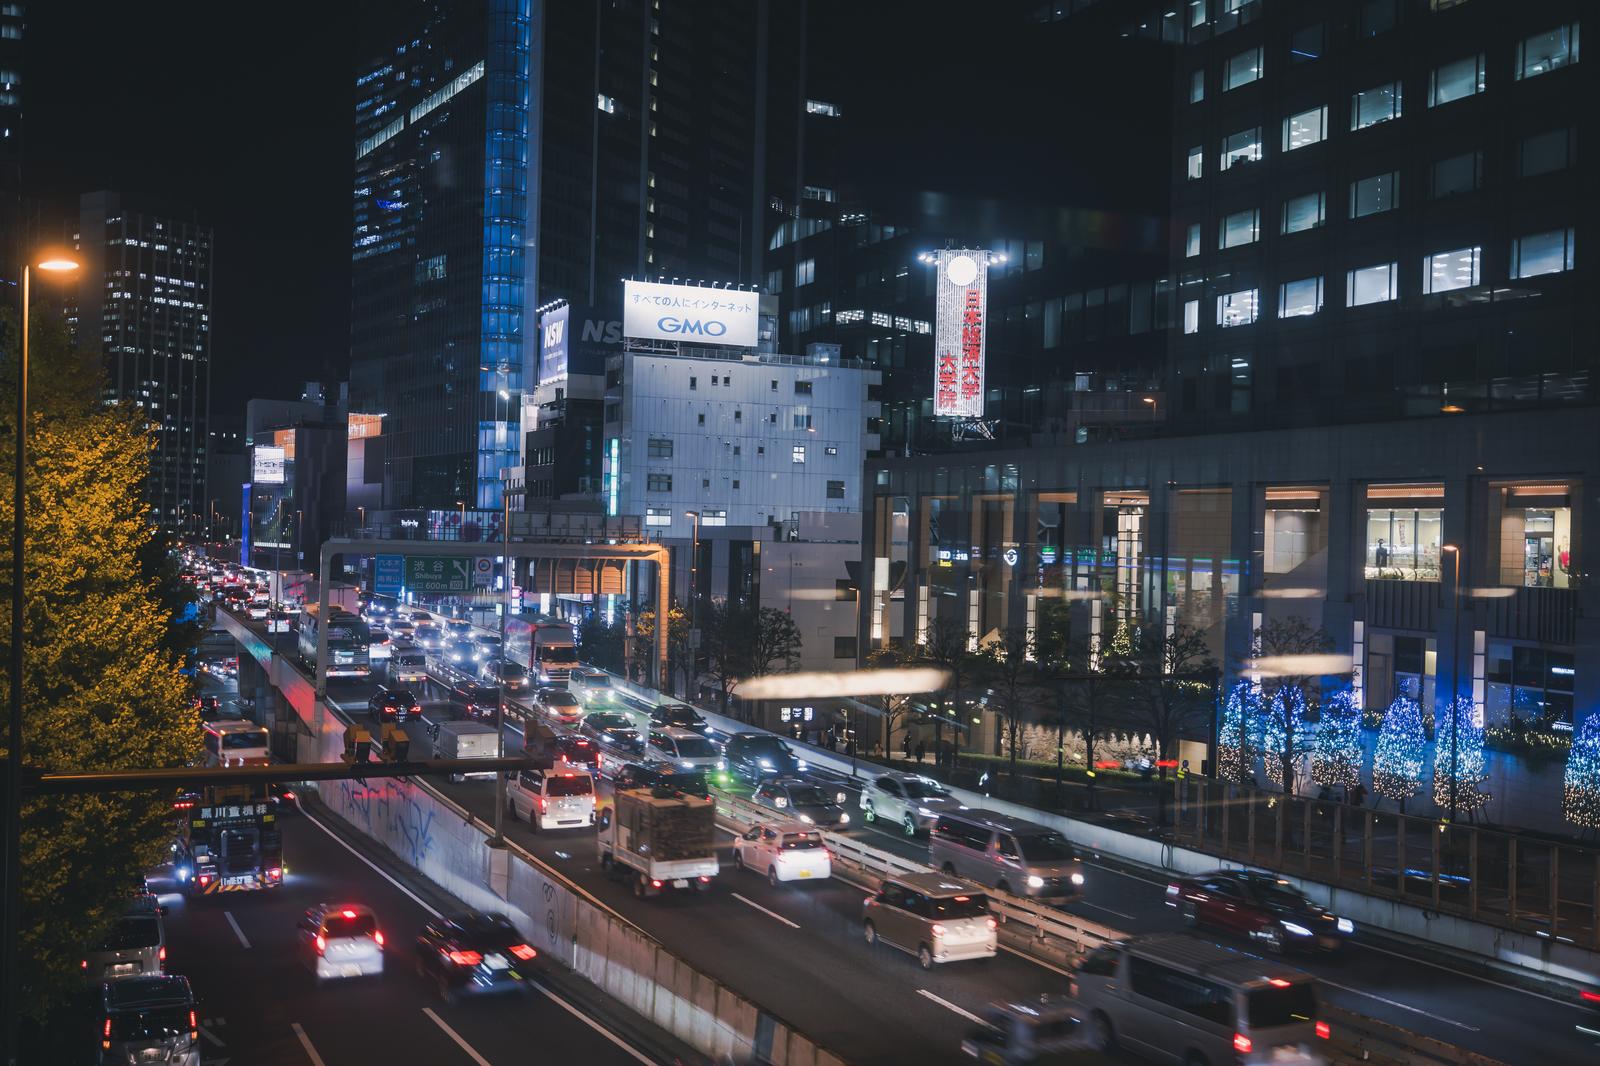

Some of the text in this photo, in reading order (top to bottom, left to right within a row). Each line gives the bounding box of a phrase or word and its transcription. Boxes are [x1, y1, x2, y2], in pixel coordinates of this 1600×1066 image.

[632, 293, 752, 314] すべての人にインターネット
[544, 319, 564, 349] NSW
[581, 319, 622, 344] NS
[657, 316, 727, 337] GMO
[961, 289, 982, 400] 日本経済大学
[414, 559, 444, 572] 渋谷
[415, 572, 442, 580] Shibuya
